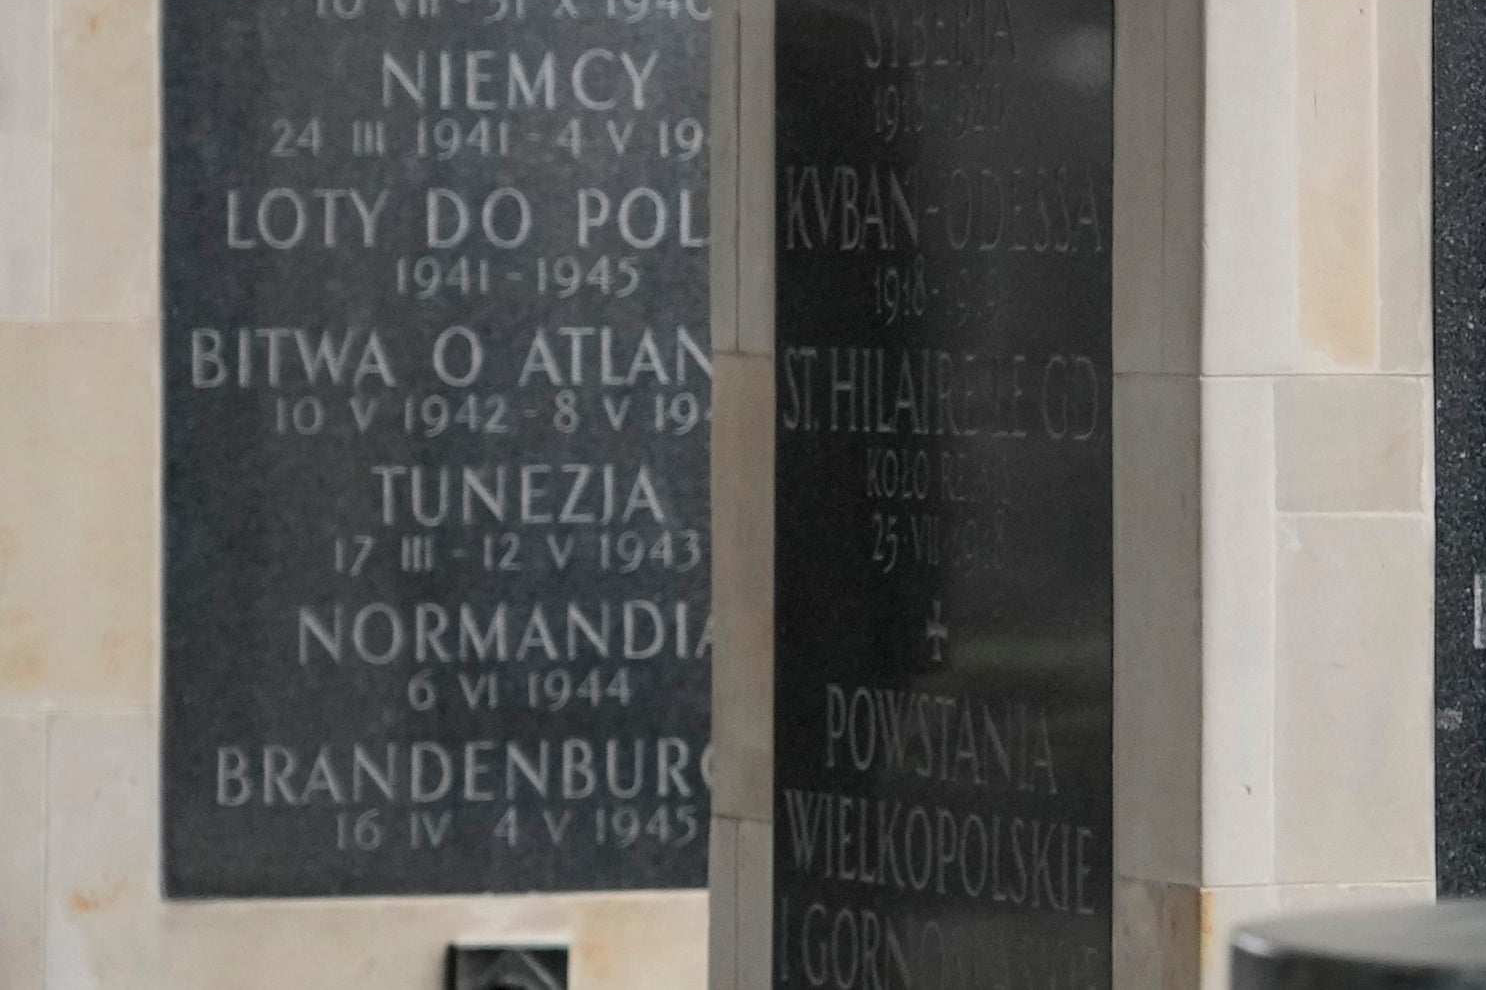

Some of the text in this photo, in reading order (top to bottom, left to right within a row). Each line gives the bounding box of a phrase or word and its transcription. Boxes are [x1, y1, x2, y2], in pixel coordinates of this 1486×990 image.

[382, 48, 661, 111] NIEMCY
[271, 116, 322, 158] 24
[352, 119, 385, 158] III
[416, 116, 510, 160] 1941
[556, 117, 583, 158] 4
[607, 119, 634, 154] V
[659, 117, 711, 161] 19
[227, 187, 388, 249] LOTY
[427, 187, 532, 250] DO
[191, 326, 398, 389] BITWA
[433, 325, 484, 387] O
[276, 395, 323, 436] 10
[351, 399, 376, 434] V
[405, 394, 508, 437] 1942
[553, 389, 580, 433] 8
[604, 397, 631, 430] V
[655, 391, 712, 436] 19
[371, 464, 665, 528] TUNEZJA
[334, 536, 375, 578] 17
[401, 536, 433, 572] III
[483, 534, 521, 572] 12
[547, 535, 574, 571] V
[601, 529, 701, 575] 1943
[408, 668, 632, 711] 6 VI 1944
[825, 682, 1059, 796] POWSTANIA
[217, 737, 712, 807] BRANDENBUR
[336, 805, 698, 852] 16 IV 4 V 1945
[784, 788, 1094, 915] WIELKOPOLSKIE
